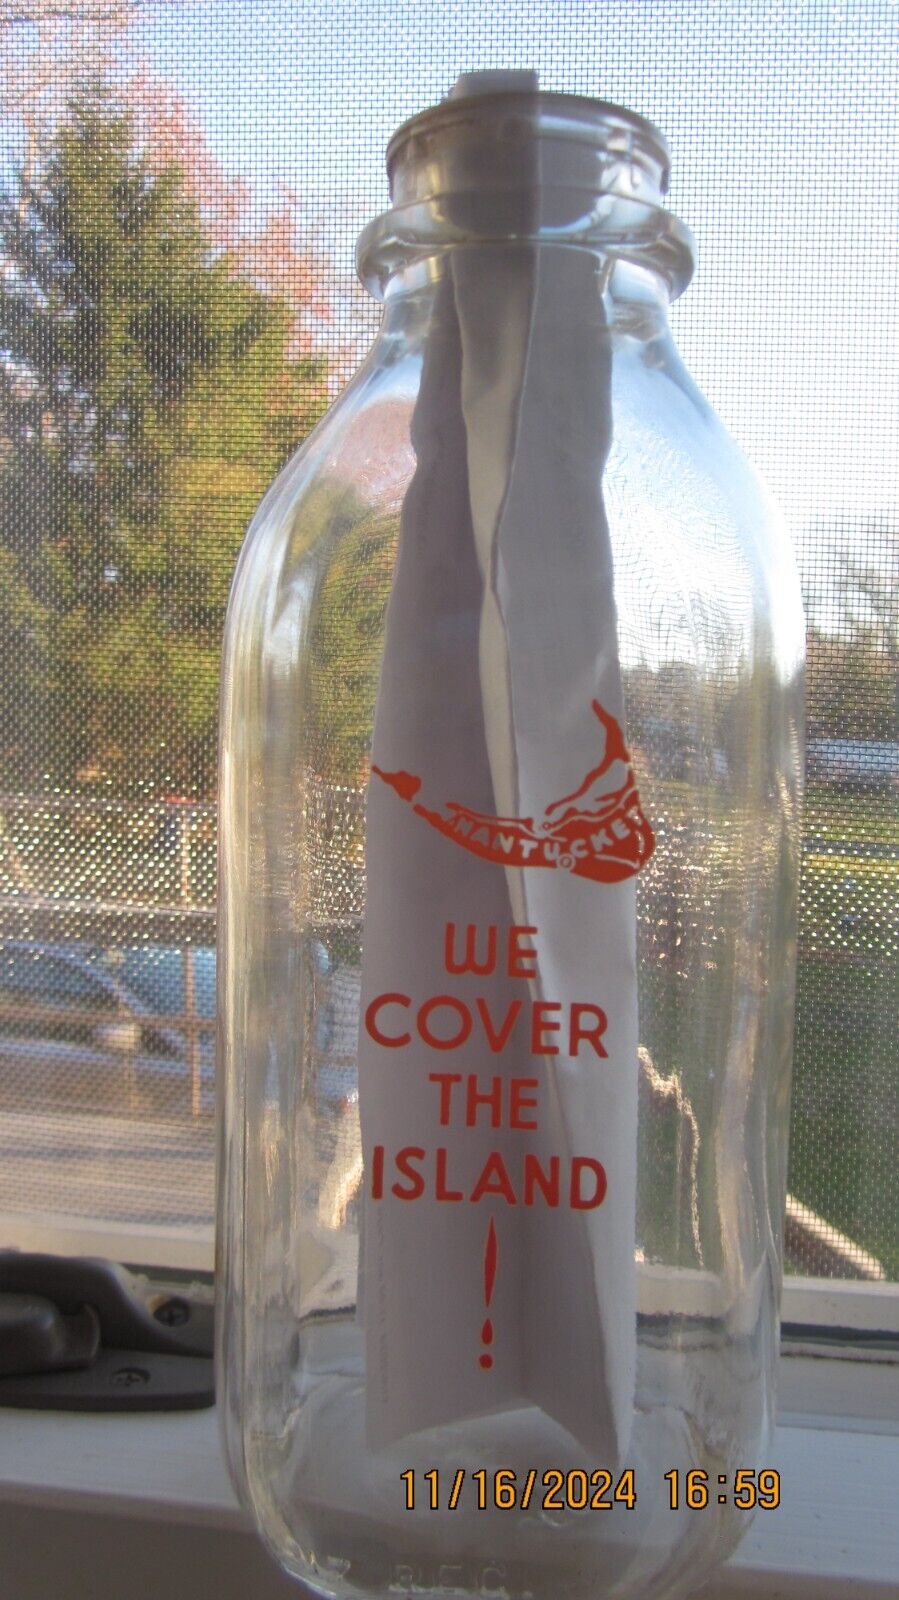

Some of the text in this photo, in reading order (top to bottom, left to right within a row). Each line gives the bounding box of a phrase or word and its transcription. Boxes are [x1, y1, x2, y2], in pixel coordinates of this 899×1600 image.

[454, 805, 645, 862] NANTUCKET
[444, 922, 537, 979] WE
[365, 992, 608, 1058] COVER
[429, 1073, 539, 1130] THE
[372, 1146, 607, 1210] ISLAND
